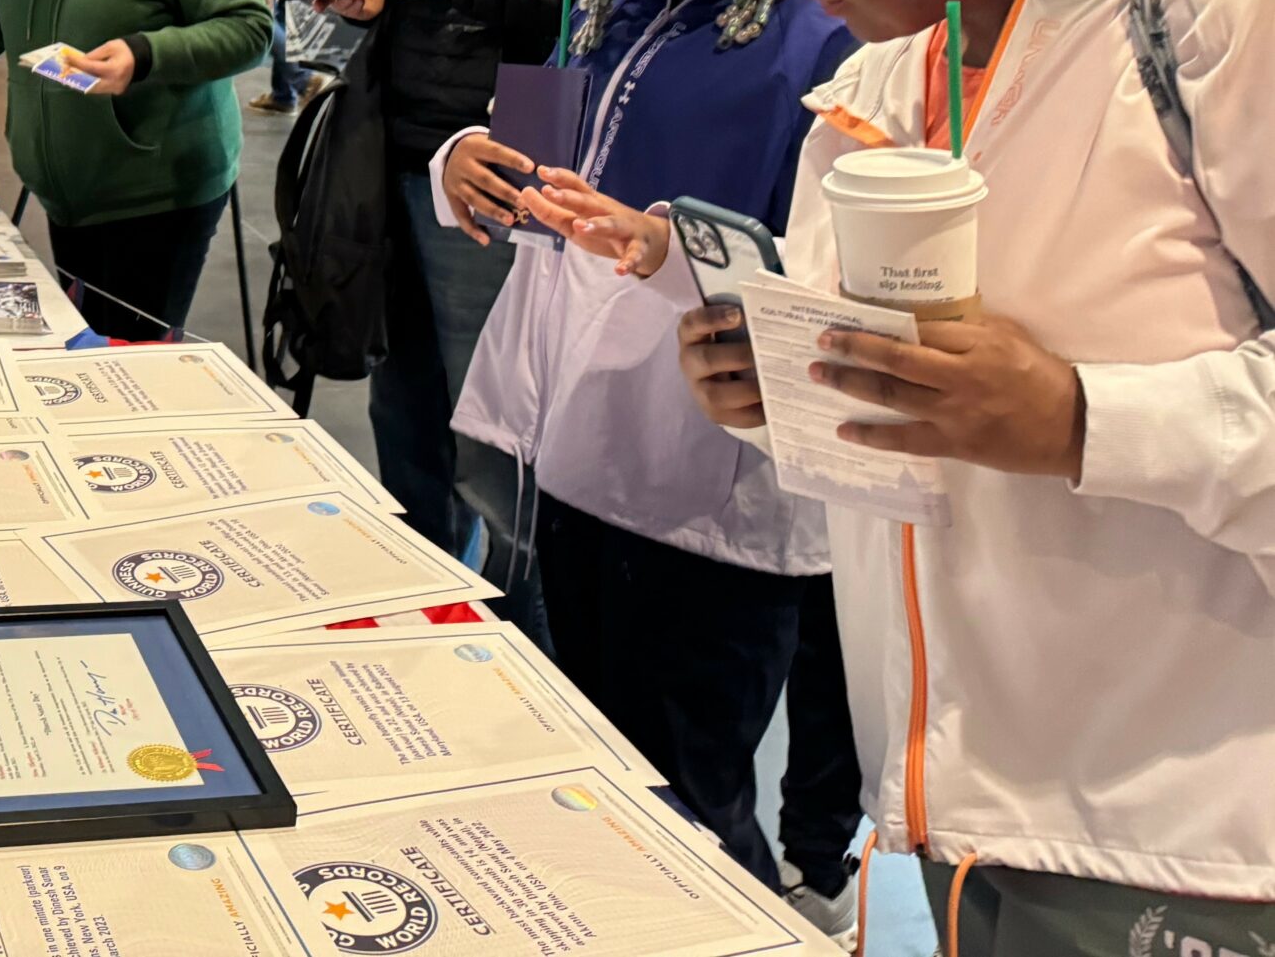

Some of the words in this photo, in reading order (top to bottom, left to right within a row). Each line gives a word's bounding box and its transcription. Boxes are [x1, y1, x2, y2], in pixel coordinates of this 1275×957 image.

[880, 266, 910, 278] That
[913, 267, 939, 278] first
[879, 279, 898, 291] sip
[900, 280, 943, 291] feeling.
[92, 456, 151, 478] RECORDS
[150, 450, 189, 489] CERTIFICATE
[110, 474, 151, 492] WORLD
[140, 552, 214, 573] RECORDS
[199, 540, 261, 588] CERTIFICATE
[119, 561, 167, 598] GUINNESS
[180, 573, 218, 598] WORLD
[327, 660, 346, 676] minute
[348, 669, 372, 692] achieved
[383, 677, 407, 695] August
[231, 687, 313, 718] RECORDS
[307, 678, 362, 746] CERTIFICATE
[352, 695, 371, 711] twists
[410, 712, 430, 726] USA,
[518, 696, 557, 731] OFFICIALLY
[262, 720, 314, 749] WORLD
[365, 713, 391, 736] butterfly
[400, 718, 420, 734] Sunar
[382, 737, 400, 751] most
[394, 732, 425, 760] (parkour)
[413, 736, 436, 756] Dinesh
[422, 727, 454, 756] Maryland,
[393, 753, 409, 764] The
[416, 819, 442, 838] while
[434, 818, 453, 832] was
[468, 819, 495, 838] 2022.
[601, 816, 648, 852] AMAZING
[445, 833, 467, 846] and
[454, 824, 492, 852] (Nepal),
[487, 838, 514, 854] May
[434, 838, 483, 880] somersaults
[481, 852, 511, 873] Sunar
[17, 864, 43, 897] (parkour)
[35, 866, 54, 887] Sunar
[58, 871, 70, 880] on
[318, 867, 423, 903] RECORDS
[479, 867, 517, 897] seconds
[521, 872, 549, 890] USA,
[642, 853, 702, 899] OFFICIALLY
[59, 882, 79, 901] USA,
[208, 877, 240, 917] AMAZING
[400, 846, 492, 936] CERTIFICATE
[503, 874, 538, 899] Dinesh
[43, 889, 64, 915] Dinesh
[475, 881, 521, 919] backward
[509, 897, 529, 908] 30
[540, 891, 569, 911] Ohio,
[29, 899, 49, 925] minute
[53, 916, 72, 926] by
[67, 902, 87, 922] York,
[41, 927, 55, 942] one
[75, 925, 94, 943] New
[91, 914, 111, 935] 2023.
[375, 906, 428, 949] WORLD
[511, 919, 541, 939] most
[528, 916, 576, 951] skipping
[540, 910, 585, 947] achieved
[560, 911, 598, 939] Akron,
[44, 944, 59, 952] in
[57, 927, 80, 957] chieved
[532, 940, 557, 956] The
